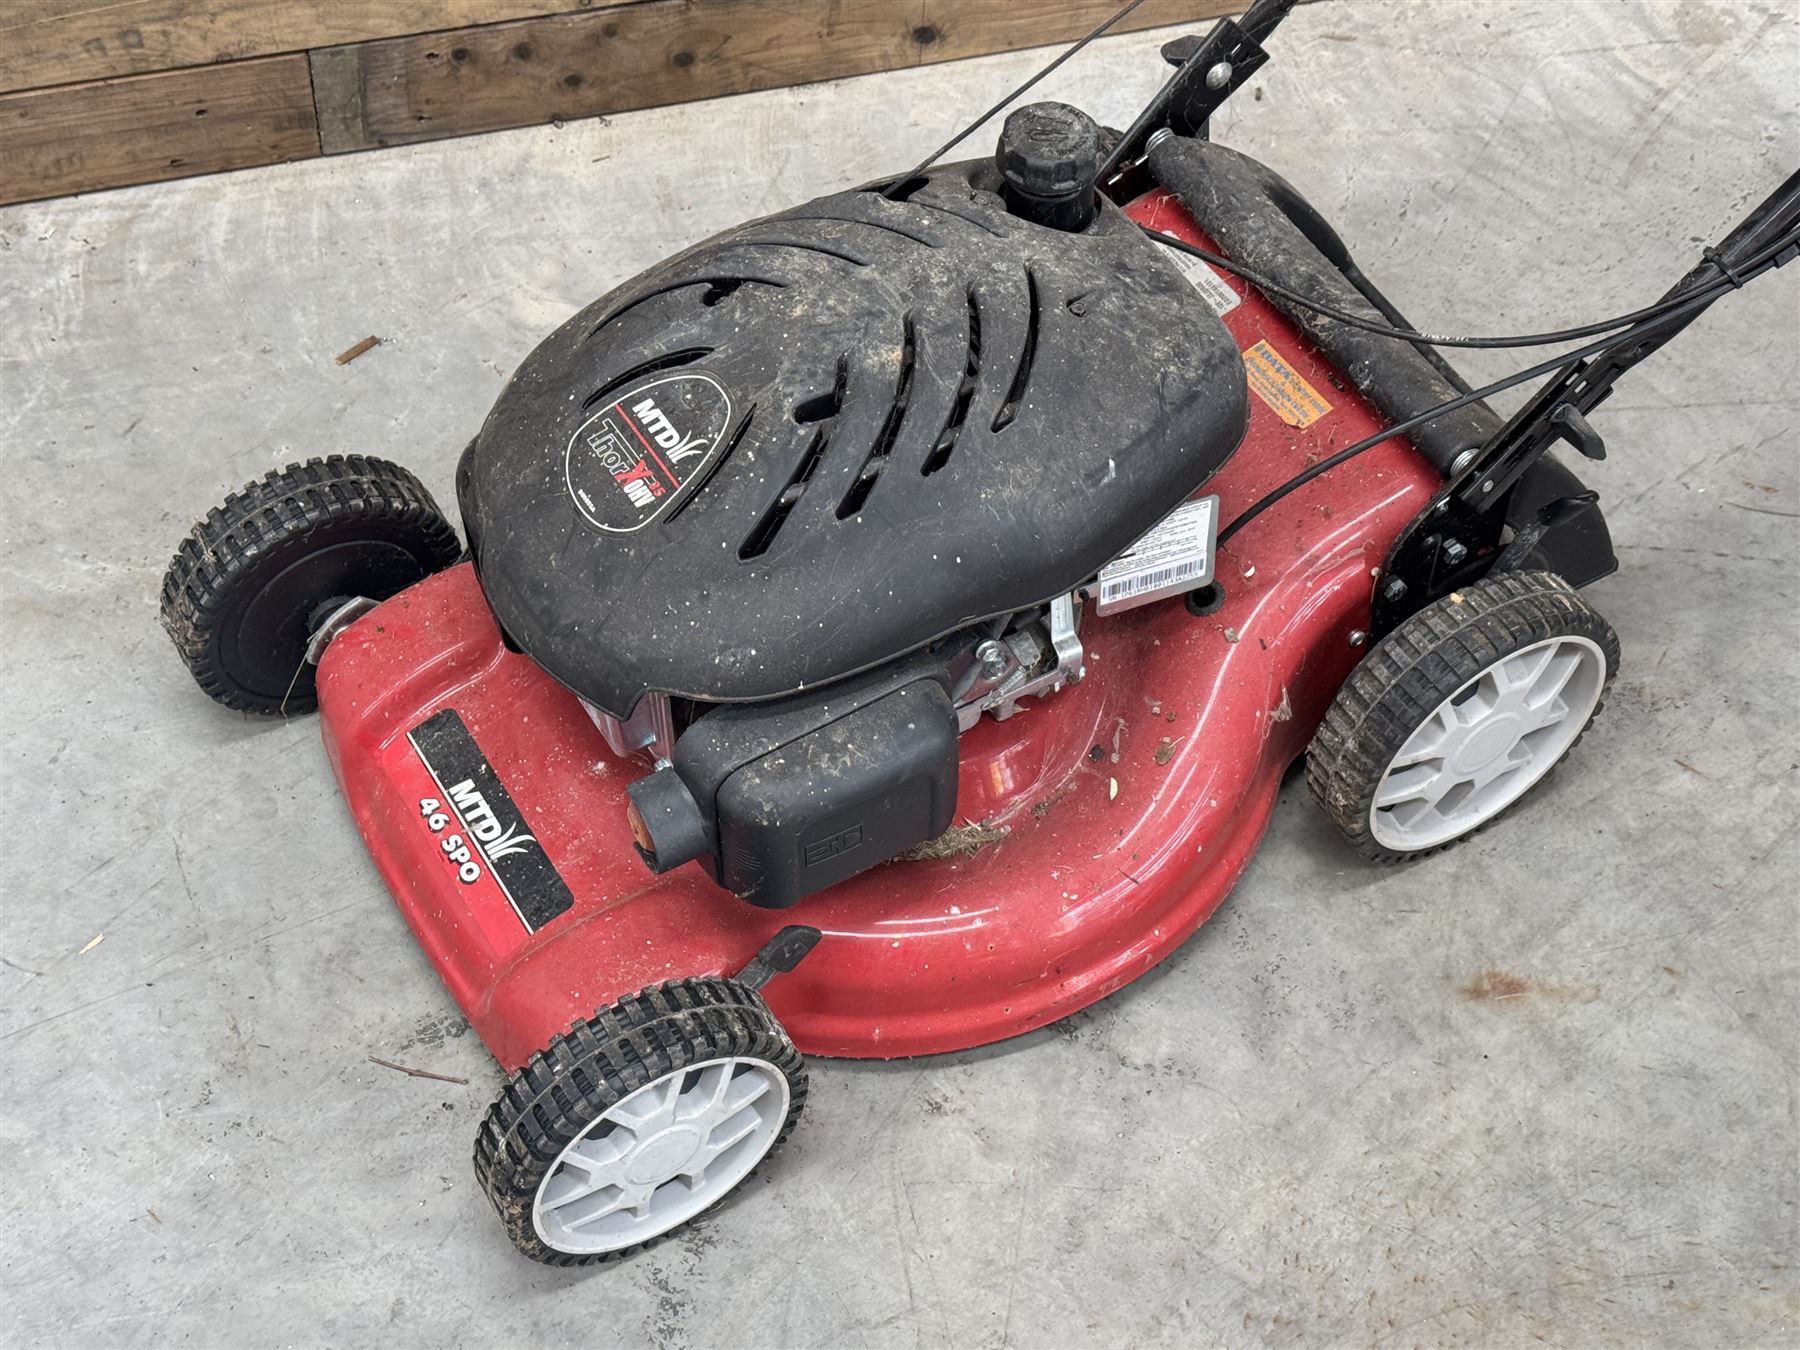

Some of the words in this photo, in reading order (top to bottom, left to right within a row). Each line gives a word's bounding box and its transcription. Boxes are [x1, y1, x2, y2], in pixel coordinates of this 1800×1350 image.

[632, 398, 681, 448] MTD
[623, 479, 656, 508] OHV
[449, 778, 502, 841] MTD
[419, 797, 450, 832] 46
[441, 834, 481, 883] SPO
